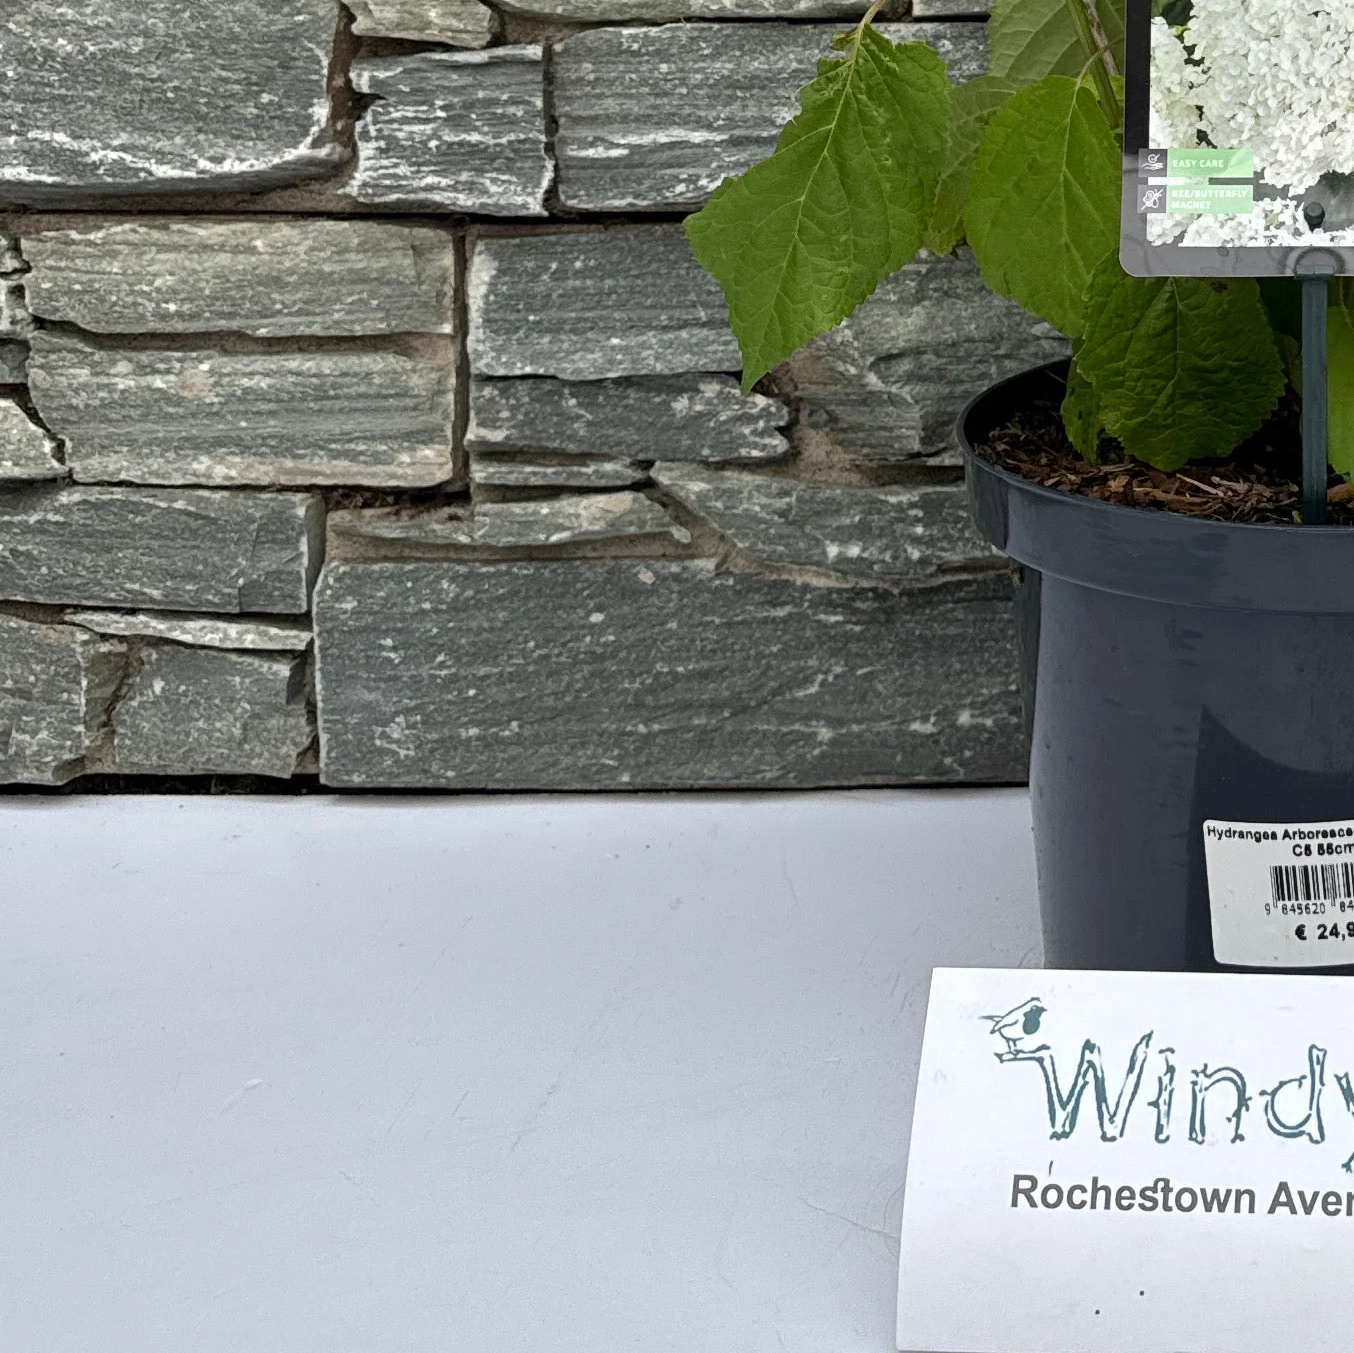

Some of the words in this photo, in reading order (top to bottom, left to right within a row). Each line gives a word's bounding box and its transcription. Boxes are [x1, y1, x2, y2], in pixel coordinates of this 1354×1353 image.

[1172, 159, 1197, 168] EASY
[1199, 159, 1225, 168] CARE
[1206, 825, 1278, 843] Hydrangea
[1281, 902, 1326, 915] 845620
[1294, 924, 1307, 941] €
[1010, 1173, 1256, 1213] Rochestown
